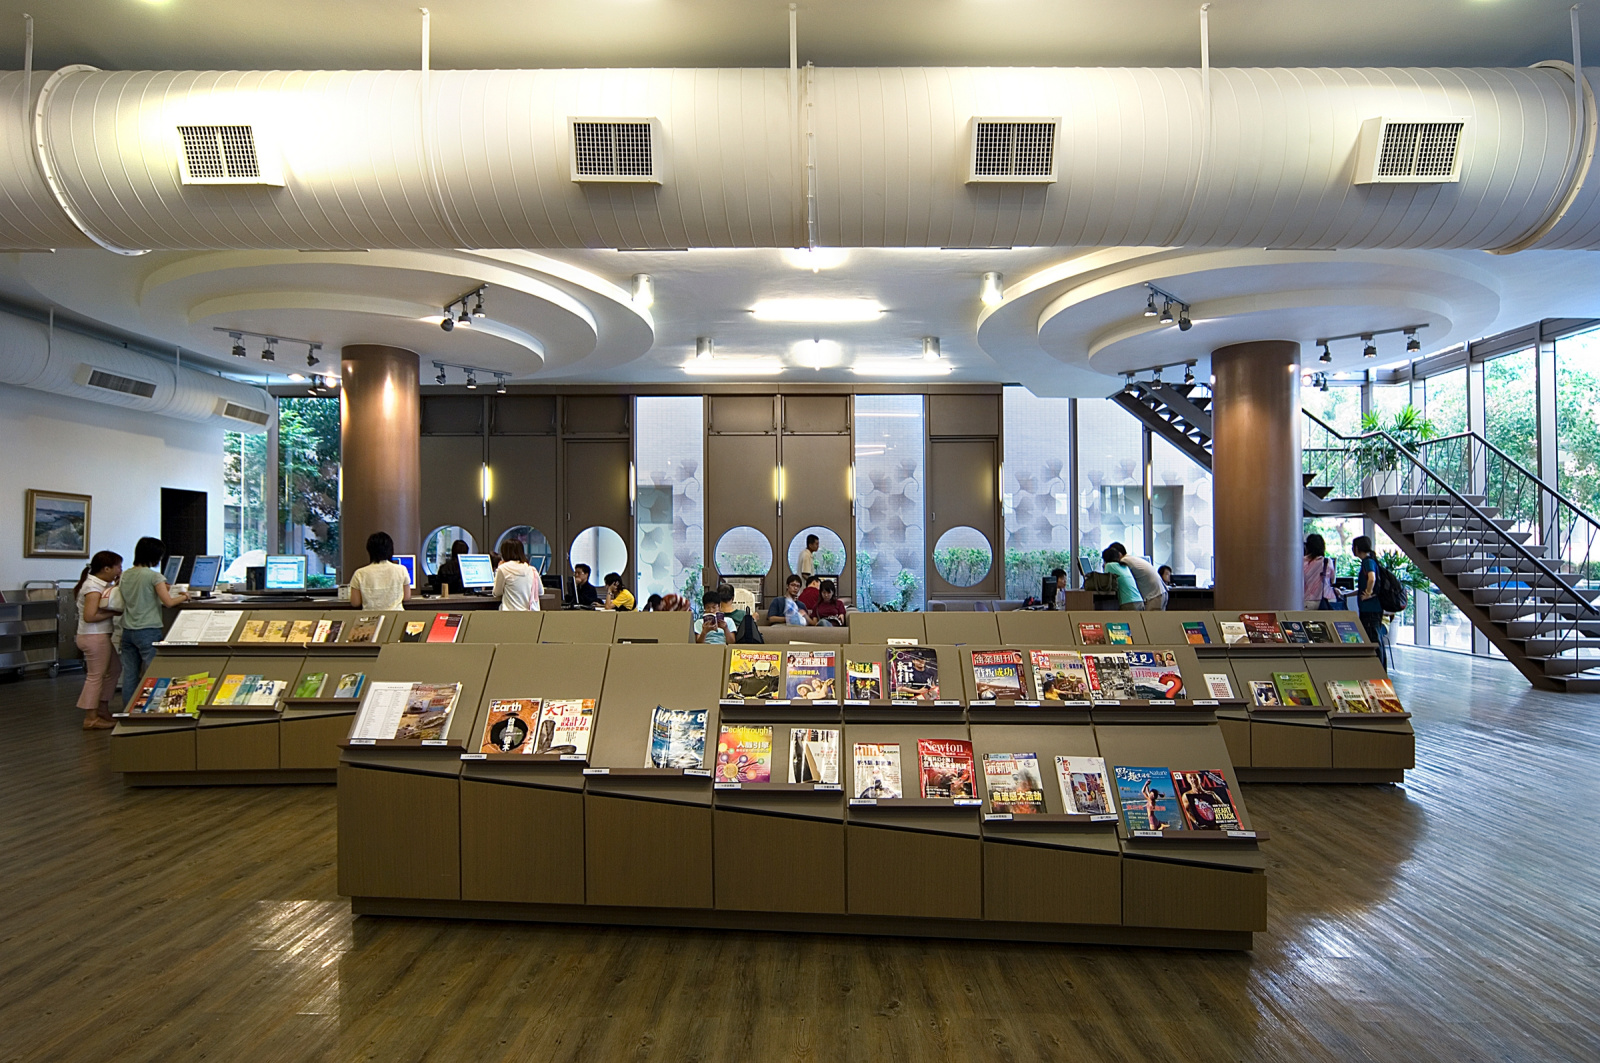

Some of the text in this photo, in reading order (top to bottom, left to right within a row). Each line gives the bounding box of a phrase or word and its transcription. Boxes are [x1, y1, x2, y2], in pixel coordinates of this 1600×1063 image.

[493, 701, 522, 713] Earth
[545, 703, 568, 716] 天下
[922, 742, 964, 753] Newton
